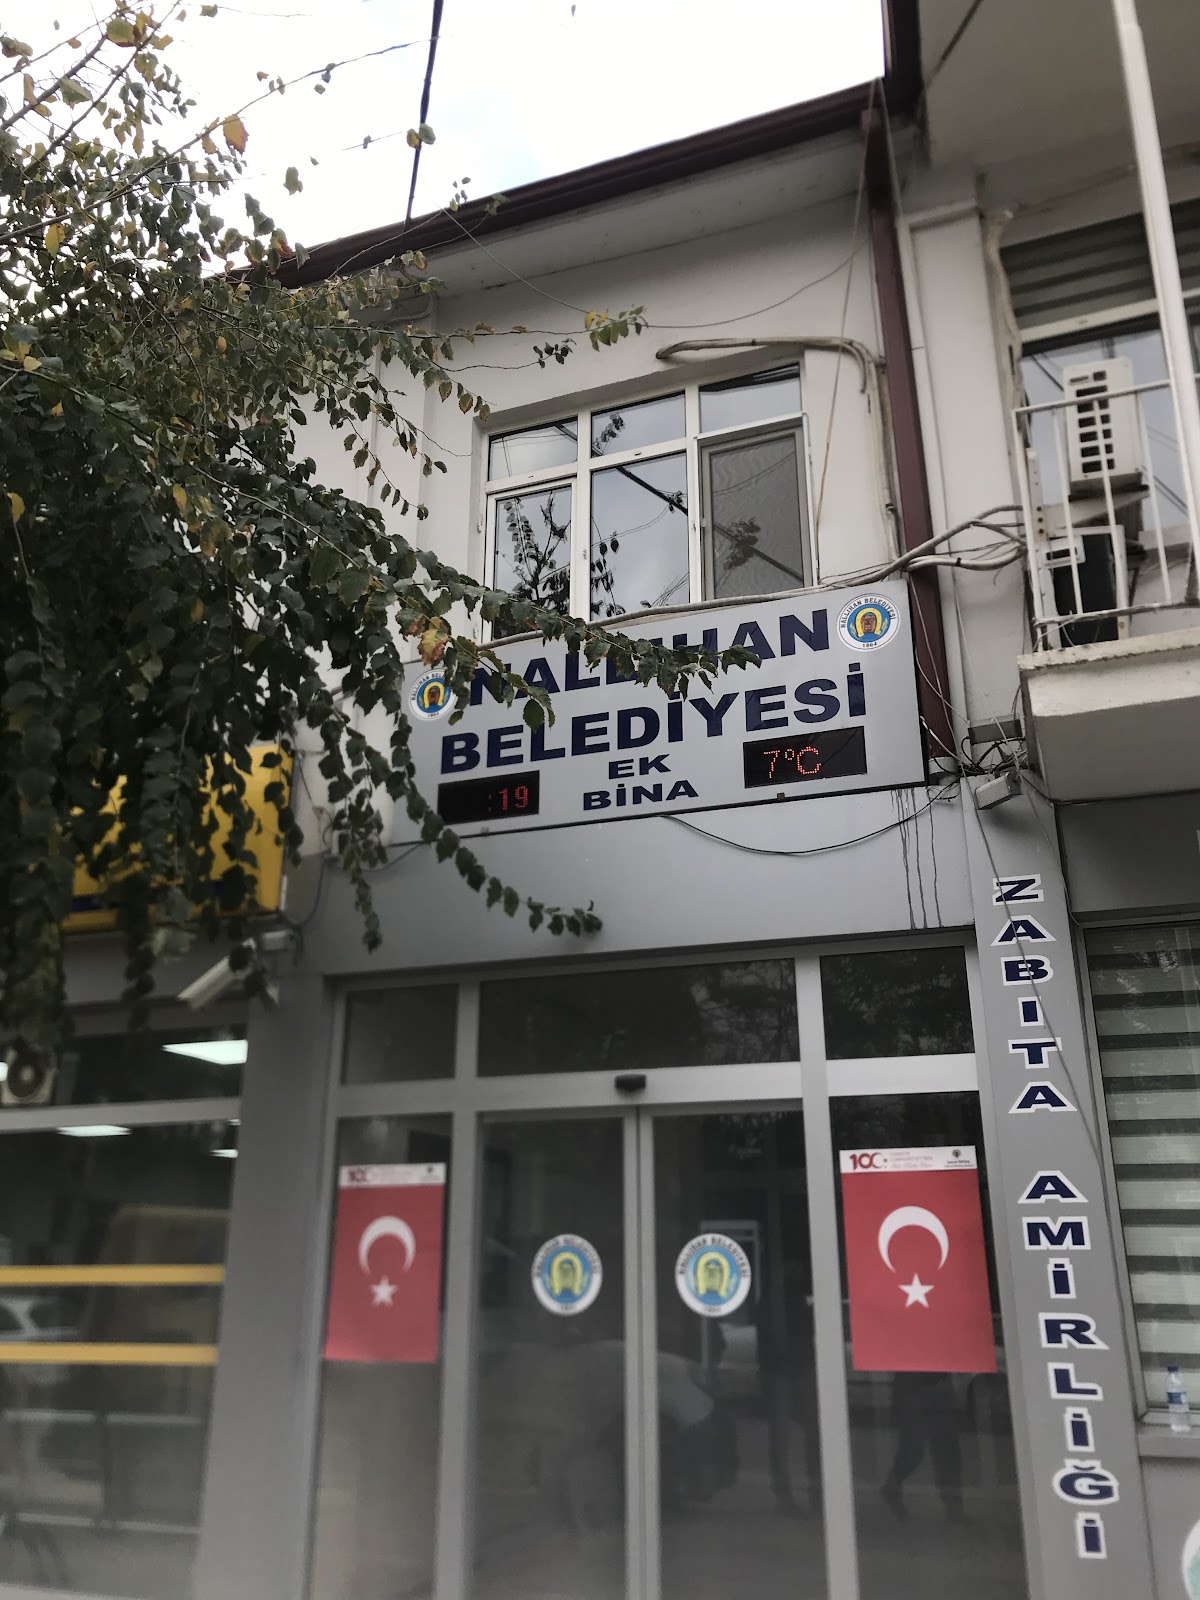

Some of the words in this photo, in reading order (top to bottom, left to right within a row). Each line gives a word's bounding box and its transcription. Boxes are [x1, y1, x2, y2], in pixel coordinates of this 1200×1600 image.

[440, 663, 866, 774] BELEDİYESİ
[608, 754, 671, 779] EK
[583, 780, 699, 811] BİNA
[991, 874, 1077, 1113] ZABITA
[1018, 1170, 1119, 1558] AMİRLİĞİ
